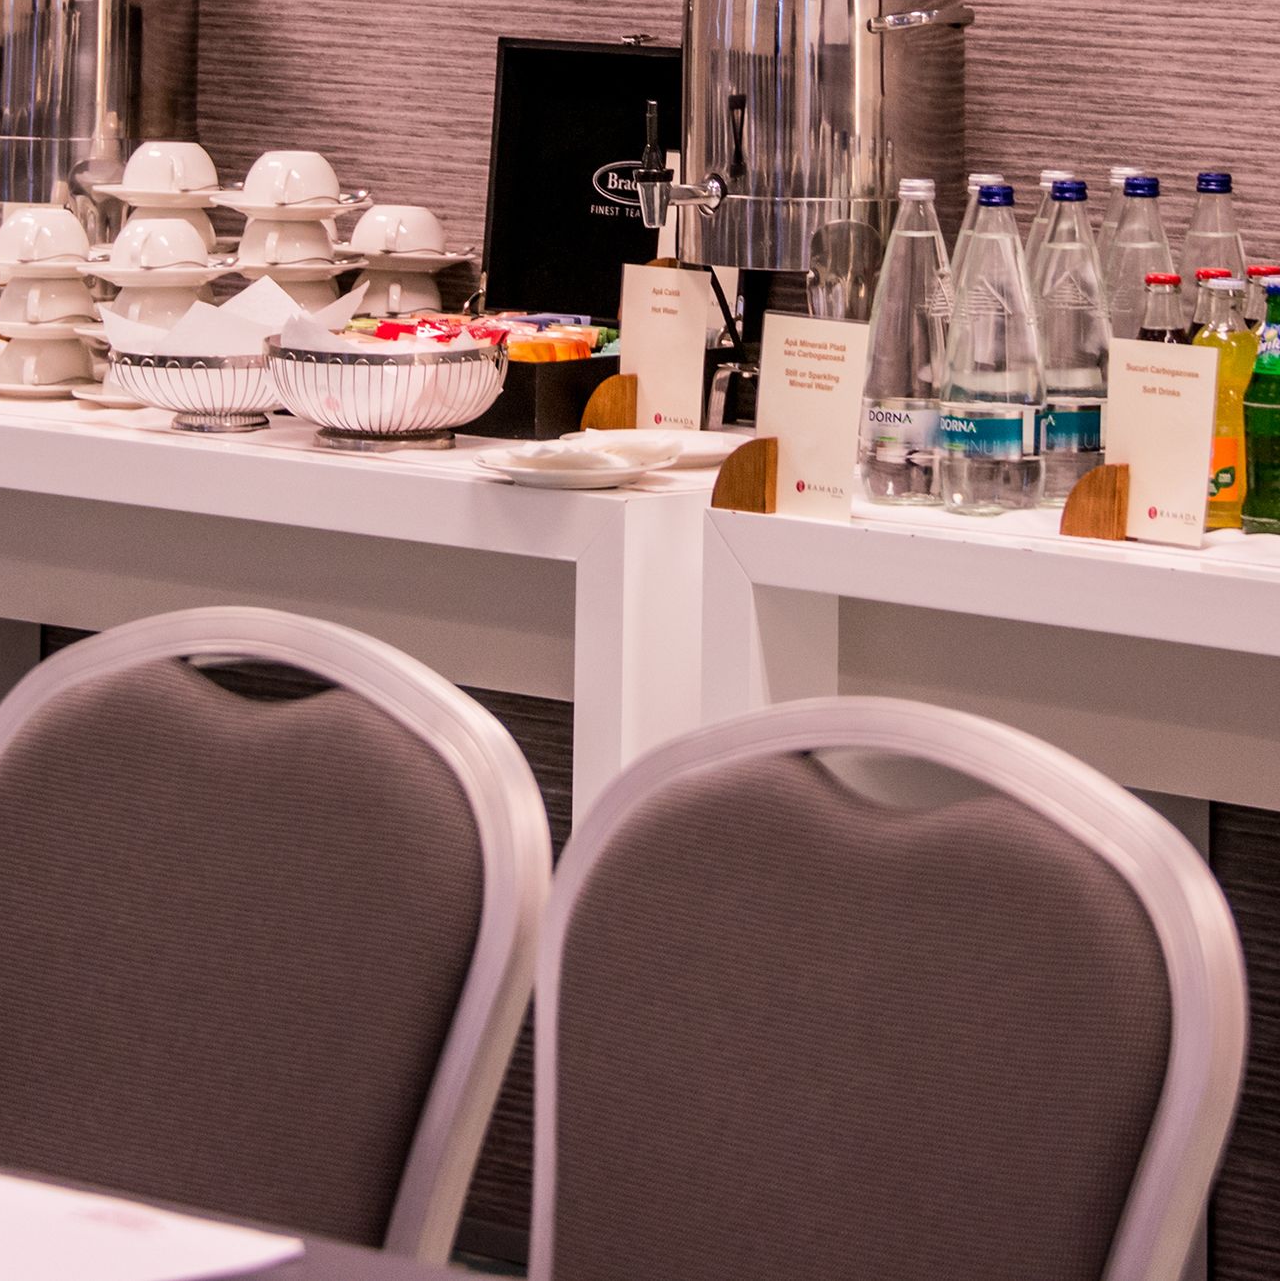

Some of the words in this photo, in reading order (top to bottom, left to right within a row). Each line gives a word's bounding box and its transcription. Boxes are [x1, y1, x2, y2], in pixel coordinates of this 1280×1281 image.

[591, 205, 620, 217] FINEST
[663, 416, 695, 426] RAMADA
[869, 409, 912, 425] DORNA
[939, 417, 977, 434] DORNA
[807, 484, 845, 495] RAMADA
